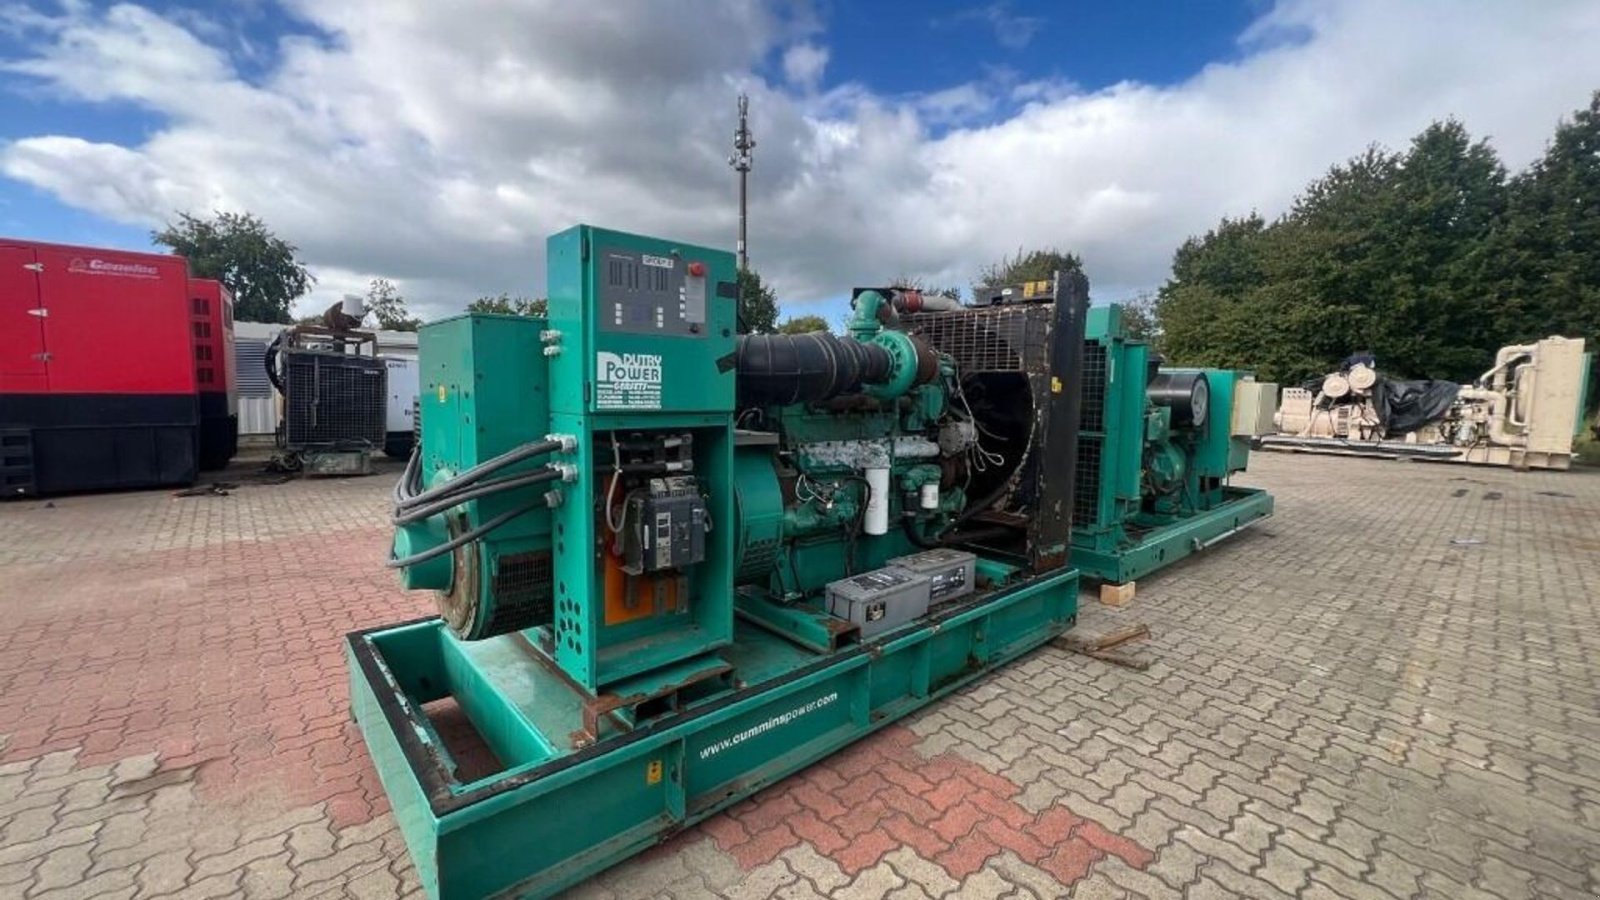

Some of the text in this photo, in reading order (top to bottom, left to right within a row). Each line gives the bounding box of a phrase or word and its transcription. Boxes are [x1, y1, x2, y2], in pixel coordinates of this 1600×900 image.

[623, 353, 662, 367] DUTRY
[606, 361, 660, 382] POWER
[700, 692, 838, 760] www.cumminspower.com
